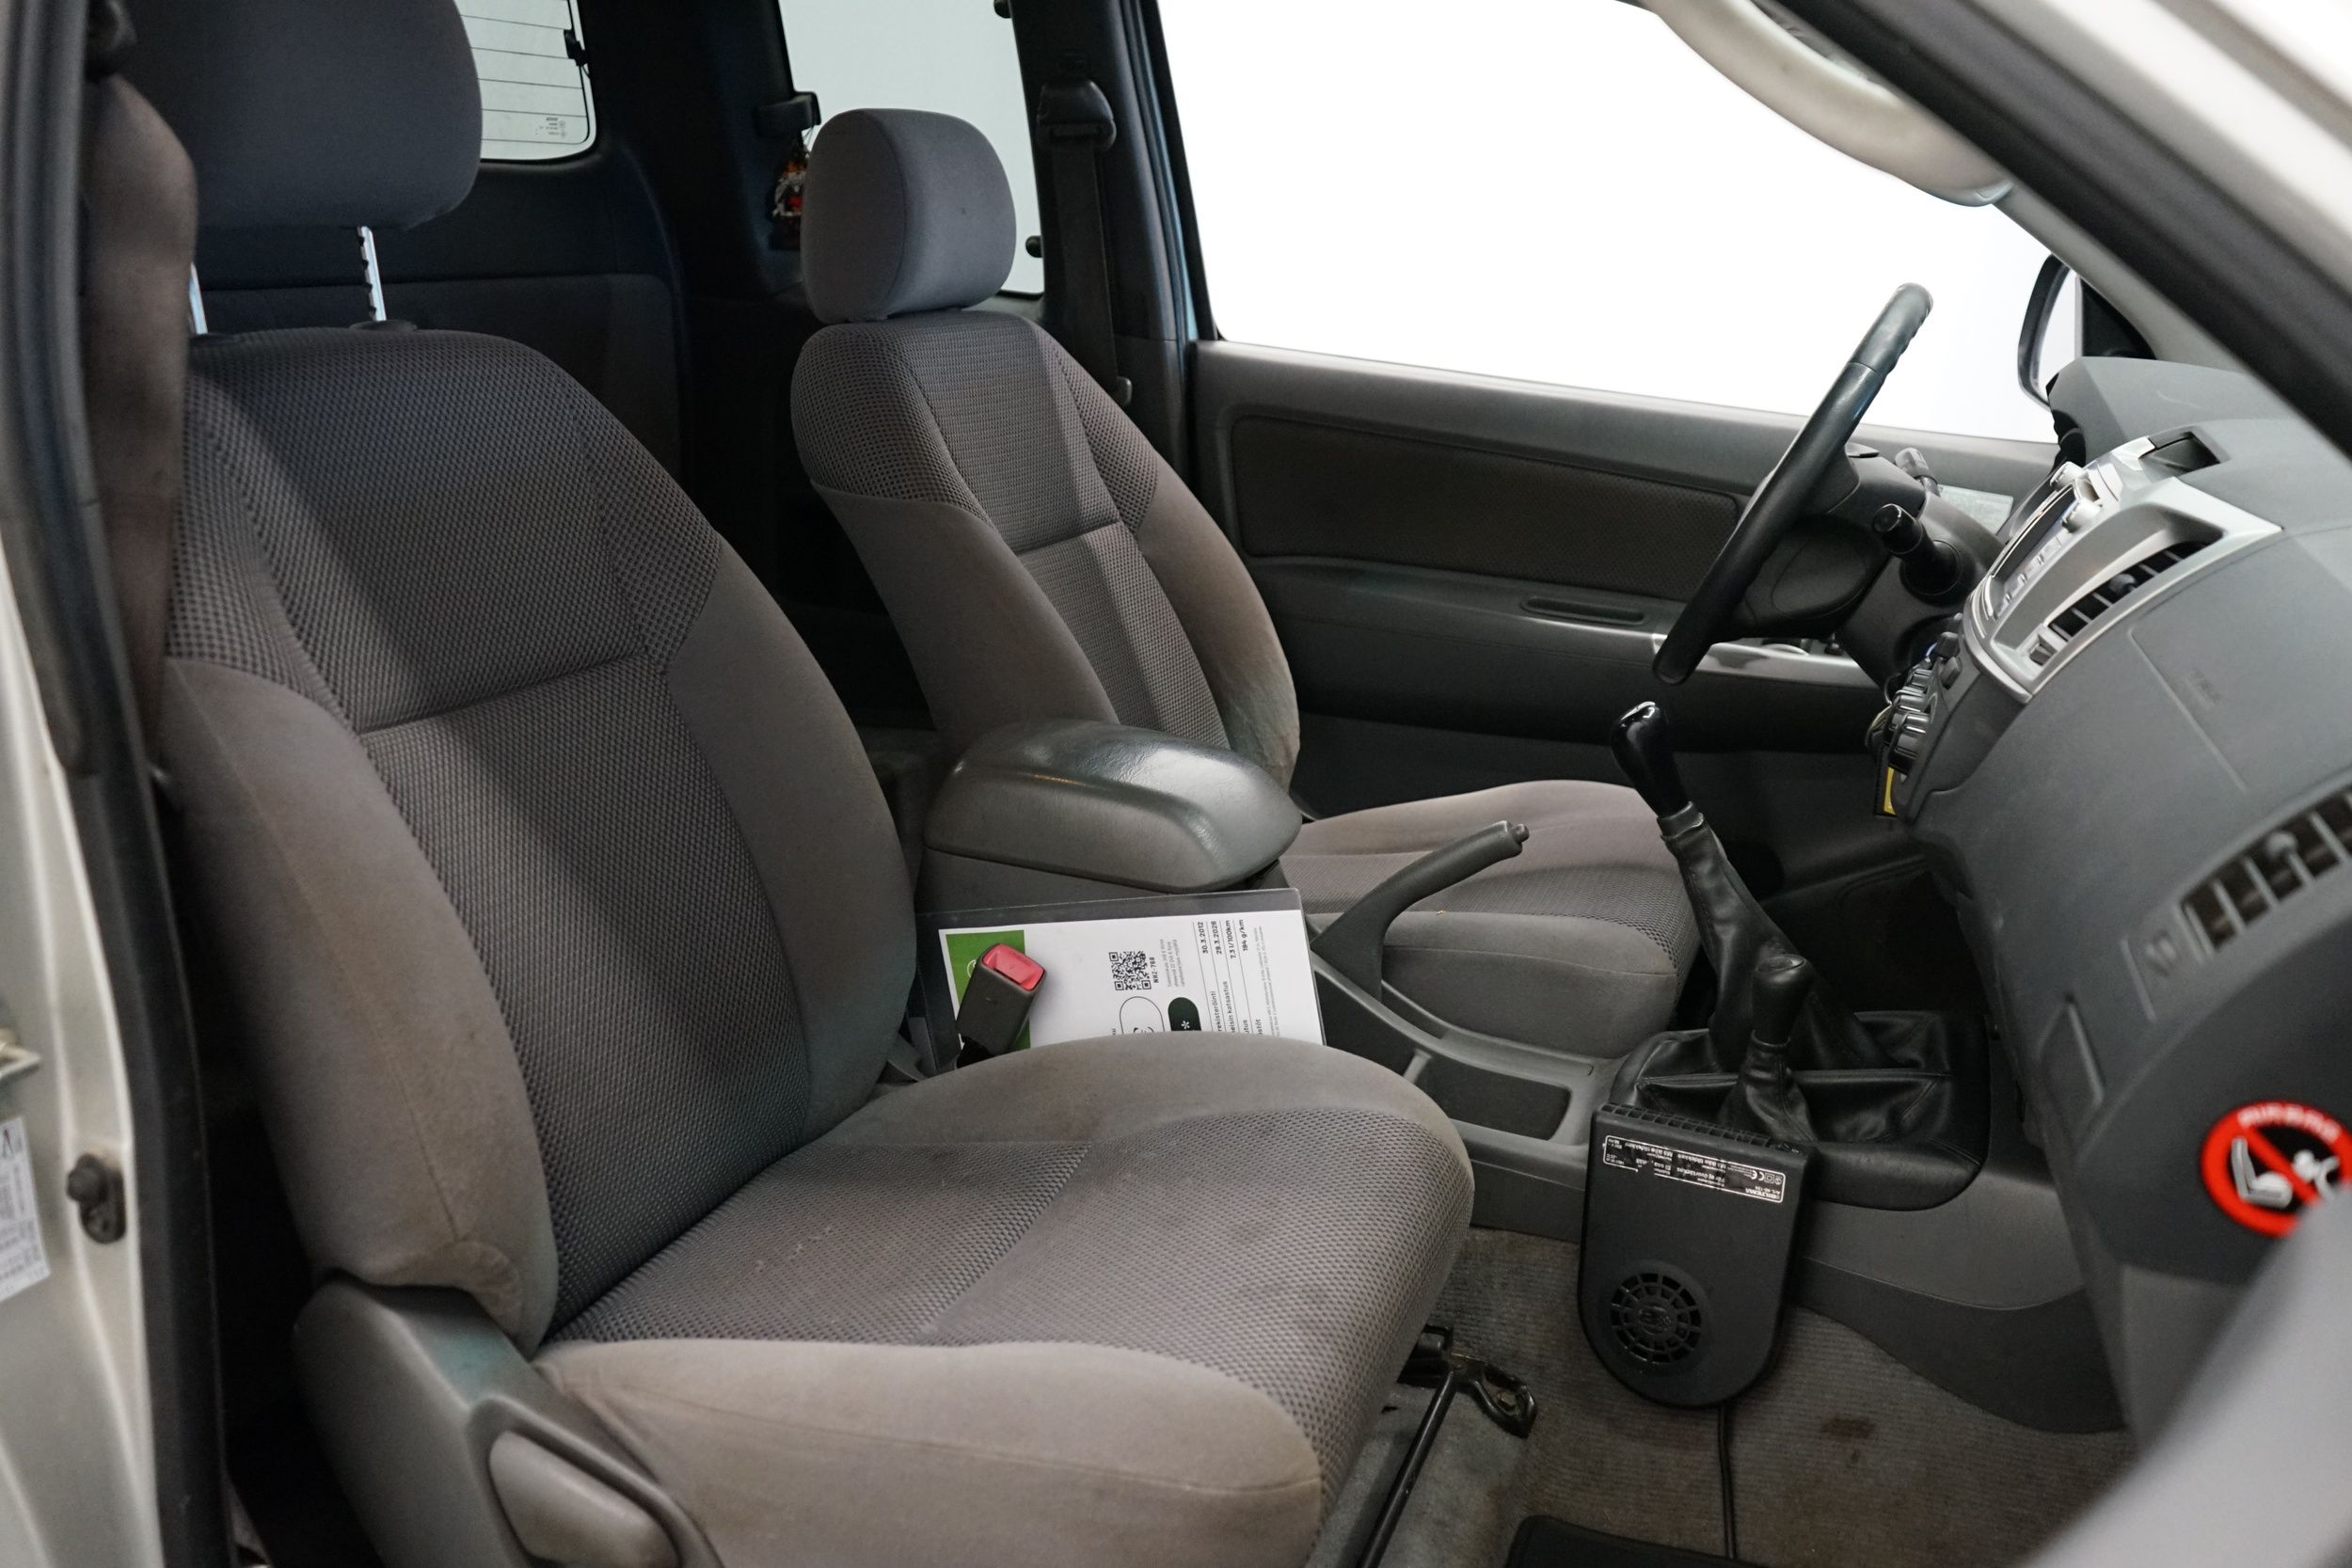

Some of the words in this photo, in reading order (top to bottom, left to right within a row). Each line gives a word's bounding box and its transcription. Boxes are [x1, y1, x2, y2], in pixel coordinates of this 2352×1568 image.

[1198, 922, 1208, 954] 30.3.2012
[1211, 921, 1221, 955] 29.3.2026
[1239, 920, 1248, 938] g/km
[1210, 990, 1222, 1031] rekisteröinti
[1223, 981, 1232, 1014] katsastus
